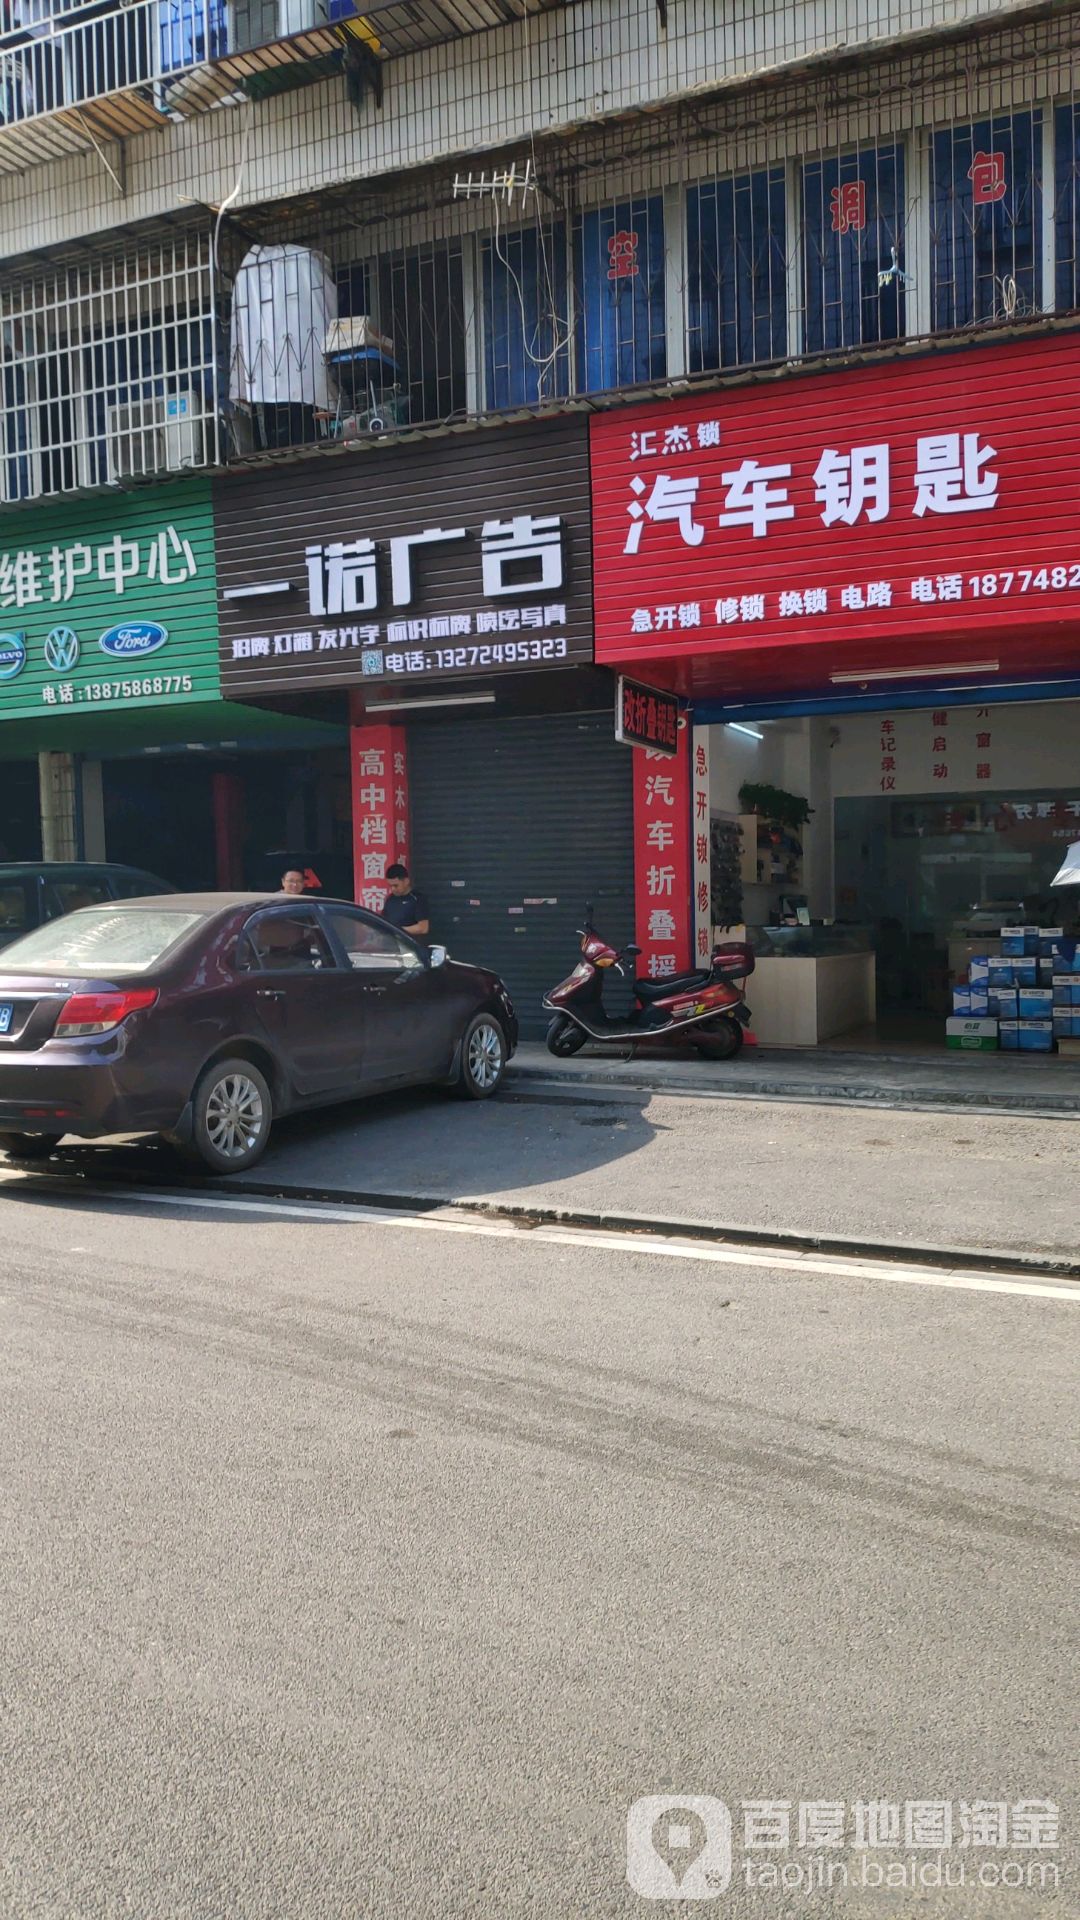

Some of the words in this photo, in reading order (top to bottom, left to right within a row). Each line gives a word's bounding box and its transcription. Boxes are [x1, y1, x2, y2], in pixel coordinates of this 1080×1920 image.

[608, 231, 638, 279] 空
[831, 181, 866, 233] 调
[969, 152, 1006, 203] 包
[629, 421, 721, 460] 汇杰锁
[622, 432, 998, 554] 汽车钥匙
[0, 525, 197, 607] 维护中心
[223, 515, 563, 617] 一诺广告
[630, 602, 701, 633] 急开锁
[714, 593, 765, 624] 修锁
[778, 587, 828, 617] 换锁
[840, 580, 893, 610] 电路
[114, 628, 152, 651] Ford
[273, 631, 314, 654] 灯箱
[317, 624, 380, 649] 发光字
[880, 720, 897, 792] 车记录仪
[359, 748, 388, 913] 高中档窗帘
[695, 745, 709, 956] 急开锁修锁
